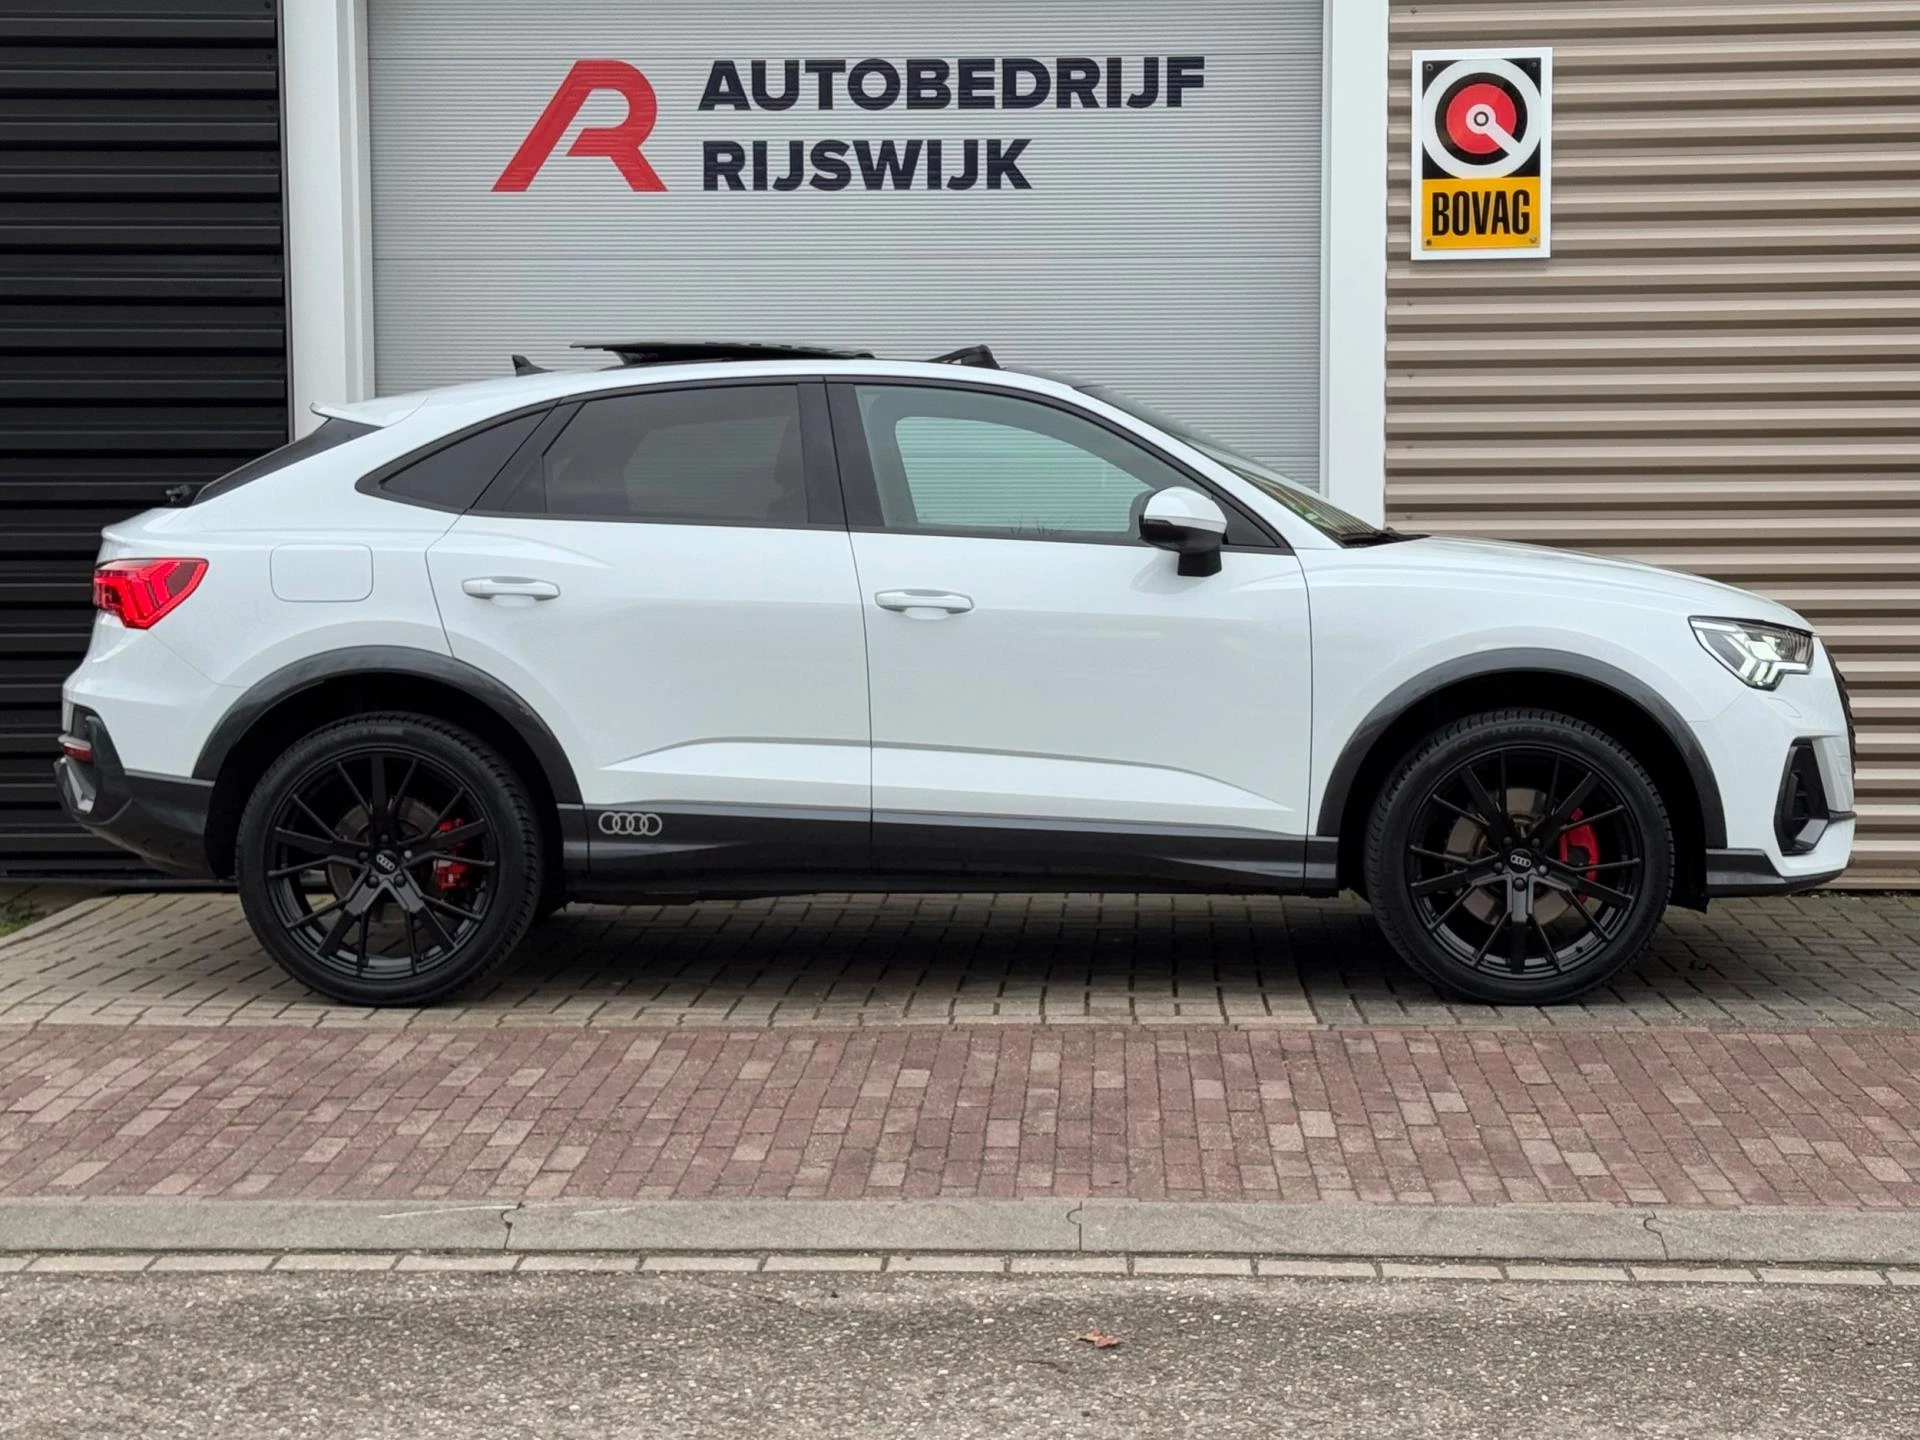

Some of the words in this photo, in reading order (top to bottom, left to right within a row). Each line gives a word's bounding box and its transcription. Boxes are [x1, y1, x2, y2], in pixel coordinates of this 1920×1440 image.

[699, 56, 1205, 111] AUTOBEDRIJF
[703, 139, 1032, 191] RIJSWIJK
[1432, 189, 1530, 236] BOVAG
